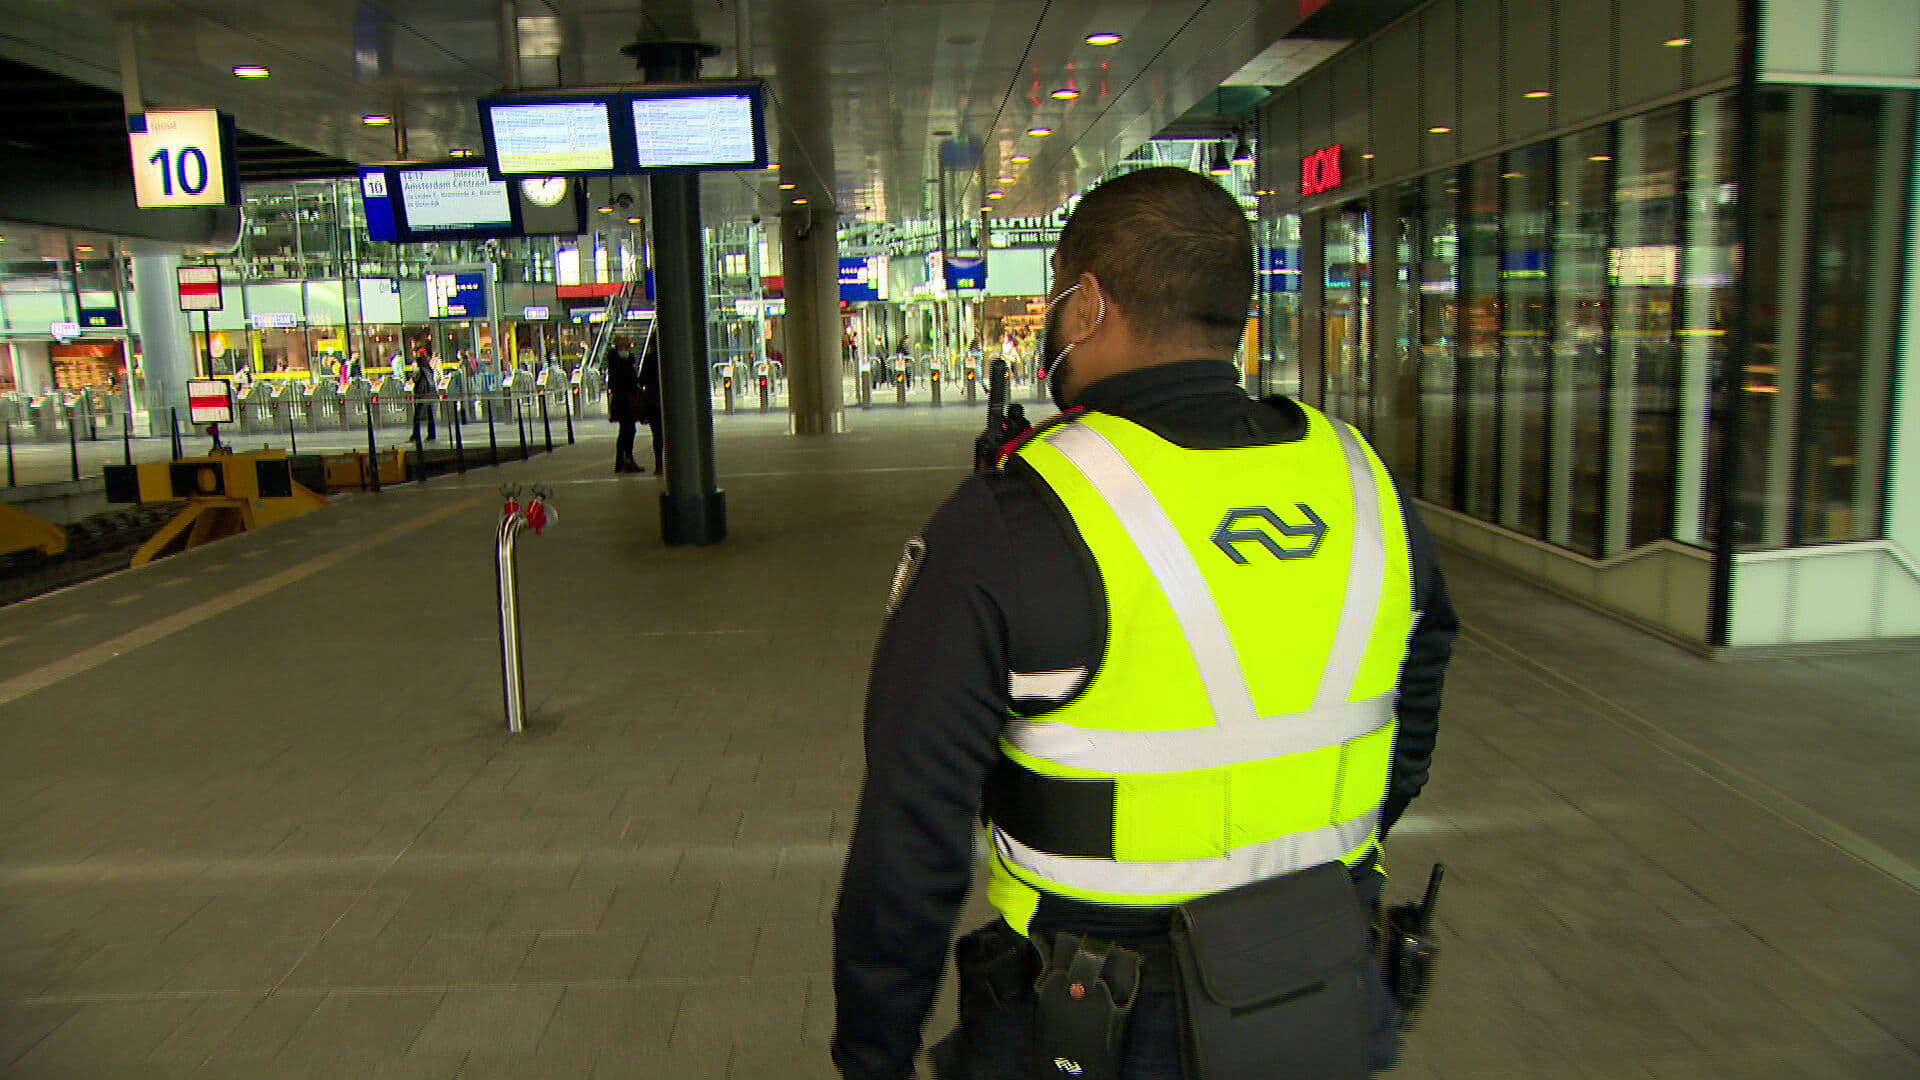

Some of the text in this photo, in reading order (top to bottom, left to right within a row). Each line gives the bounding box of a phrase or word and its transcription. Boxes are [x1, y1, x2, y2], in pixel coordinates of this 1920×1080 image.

[149, 148, 208, 197] 10
[453, 170, 486, 181] Intercity
[367, 182, 383, 195] 10
[404, 178, 487, 192] Amsterdam Centraal
